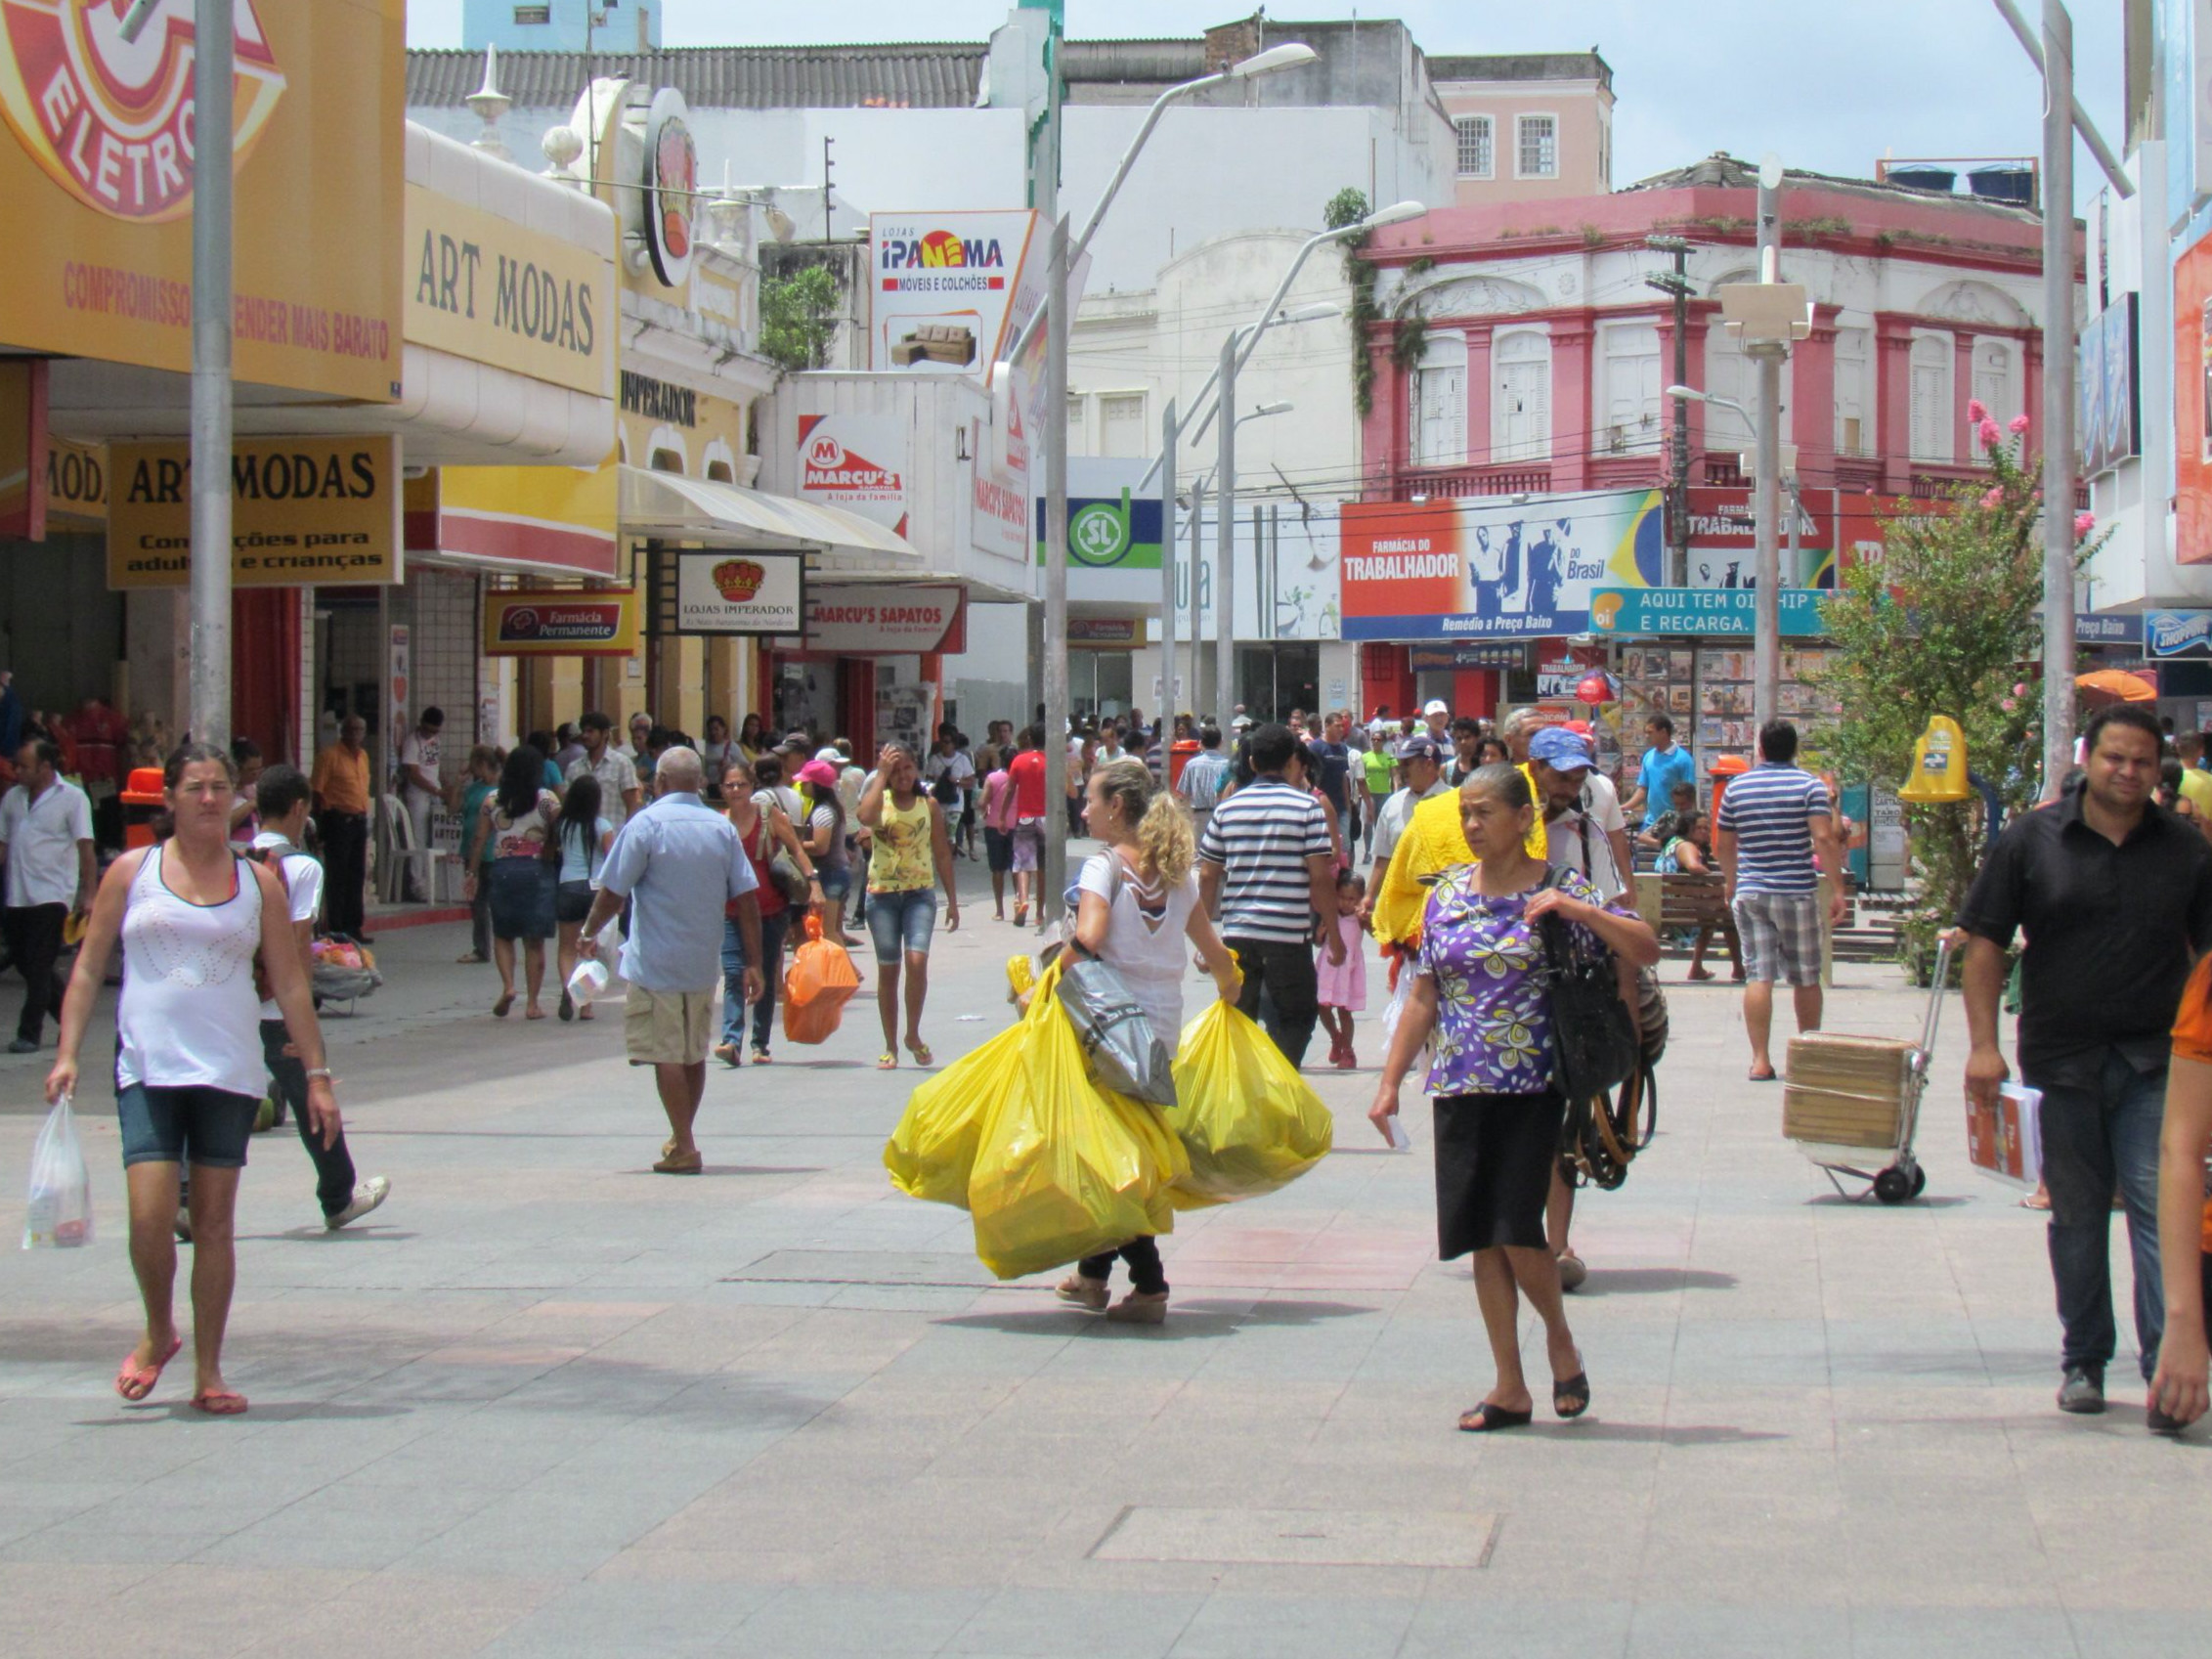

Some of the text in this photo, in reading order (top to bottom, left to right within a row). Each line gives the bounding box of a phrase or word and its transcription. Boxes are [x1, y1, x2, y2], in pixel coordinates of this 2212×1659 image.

[883, 227, 915, 238] LOJAS
[899, 275, 988, 292] MÓVEIS E COLCHÕES
[417, 229, 594, 356] ART MODAS
[64, 260, 390, 361] COMPROMISSO ENDER MAIS BARATO
[813, 442, 837, 459] M
[127, 458, 192, 503] AR
[806, 470, 896, 485] MARCU'S
[827, 493, 833, 502] A
[140, 532, 369, 550] Conções para
[1087, 519, 1111, 546] SL
[1372, 538, 1430, 553] FARMÁCIA DO
[1570, 548, 1581, 559] DO
[240, 557, 257, 569] e
[263, 553, 383, 571] crianças
[1344, 553, 1459, 582] TRABALHADOR
[1567, 559, 1604, 581] Brasil
[1640, 591, 1808, 610] AQUI TEM OI HIP
[549, 610, 601, 625] Farmácia
[684, 605, 795, 615] LOJAS IMPERADOR
[814, 607, 941, 624] MARCU'S SAPATOS
[1595, 608, 1611, 627] oi
[540, 623, 611, 637] Permanente
[1443, 613, 1552, 634] Remédio a Preço Baixo
[1641, 615, 1749, 632] E RECARGA.
